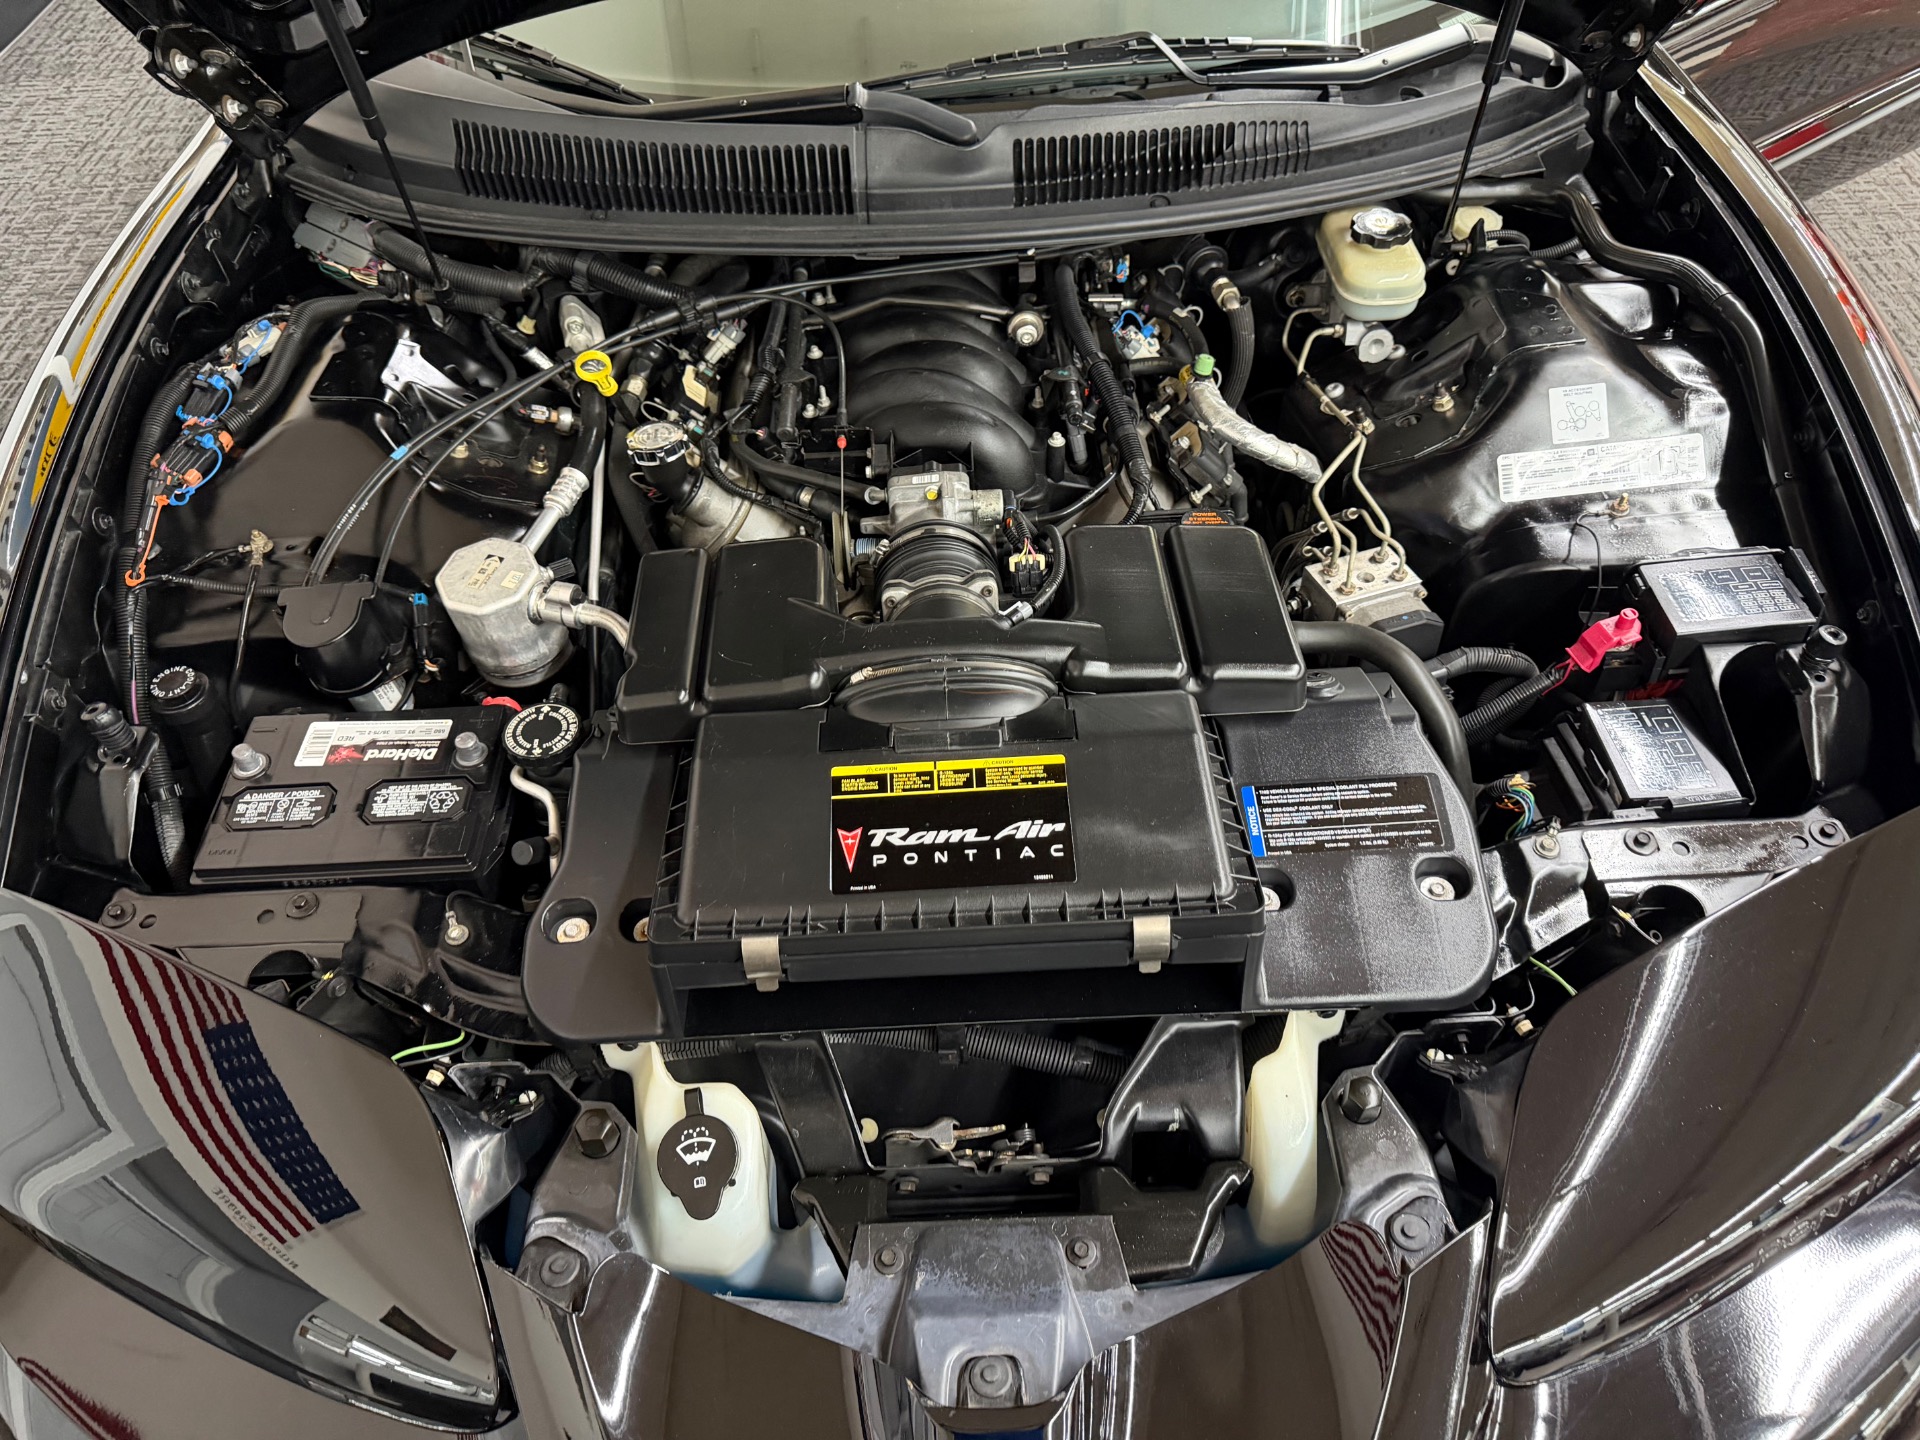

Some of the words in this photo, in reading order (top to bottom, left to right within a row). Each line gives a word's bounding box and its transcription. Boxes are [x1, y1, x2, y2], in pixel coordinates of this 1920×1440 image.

[152, 666, 187, 682] ENGINE
[168, 668, 195, 697] COOLANT
[150, 684, 165, 698] ONLY
[558, 706, 576, 725] NEVER
[565, 724, 577, 740] OPEN
[552, 738, 568, 752] HOT
[363, 748, 438, 761] DieHard
[1247, 806, 1259, 836] NOTICE
[868, 827, 991, 847] Ram
[994, 819, 1066, 841] Air
[873, 844, 1064, 868] PONTIAC
